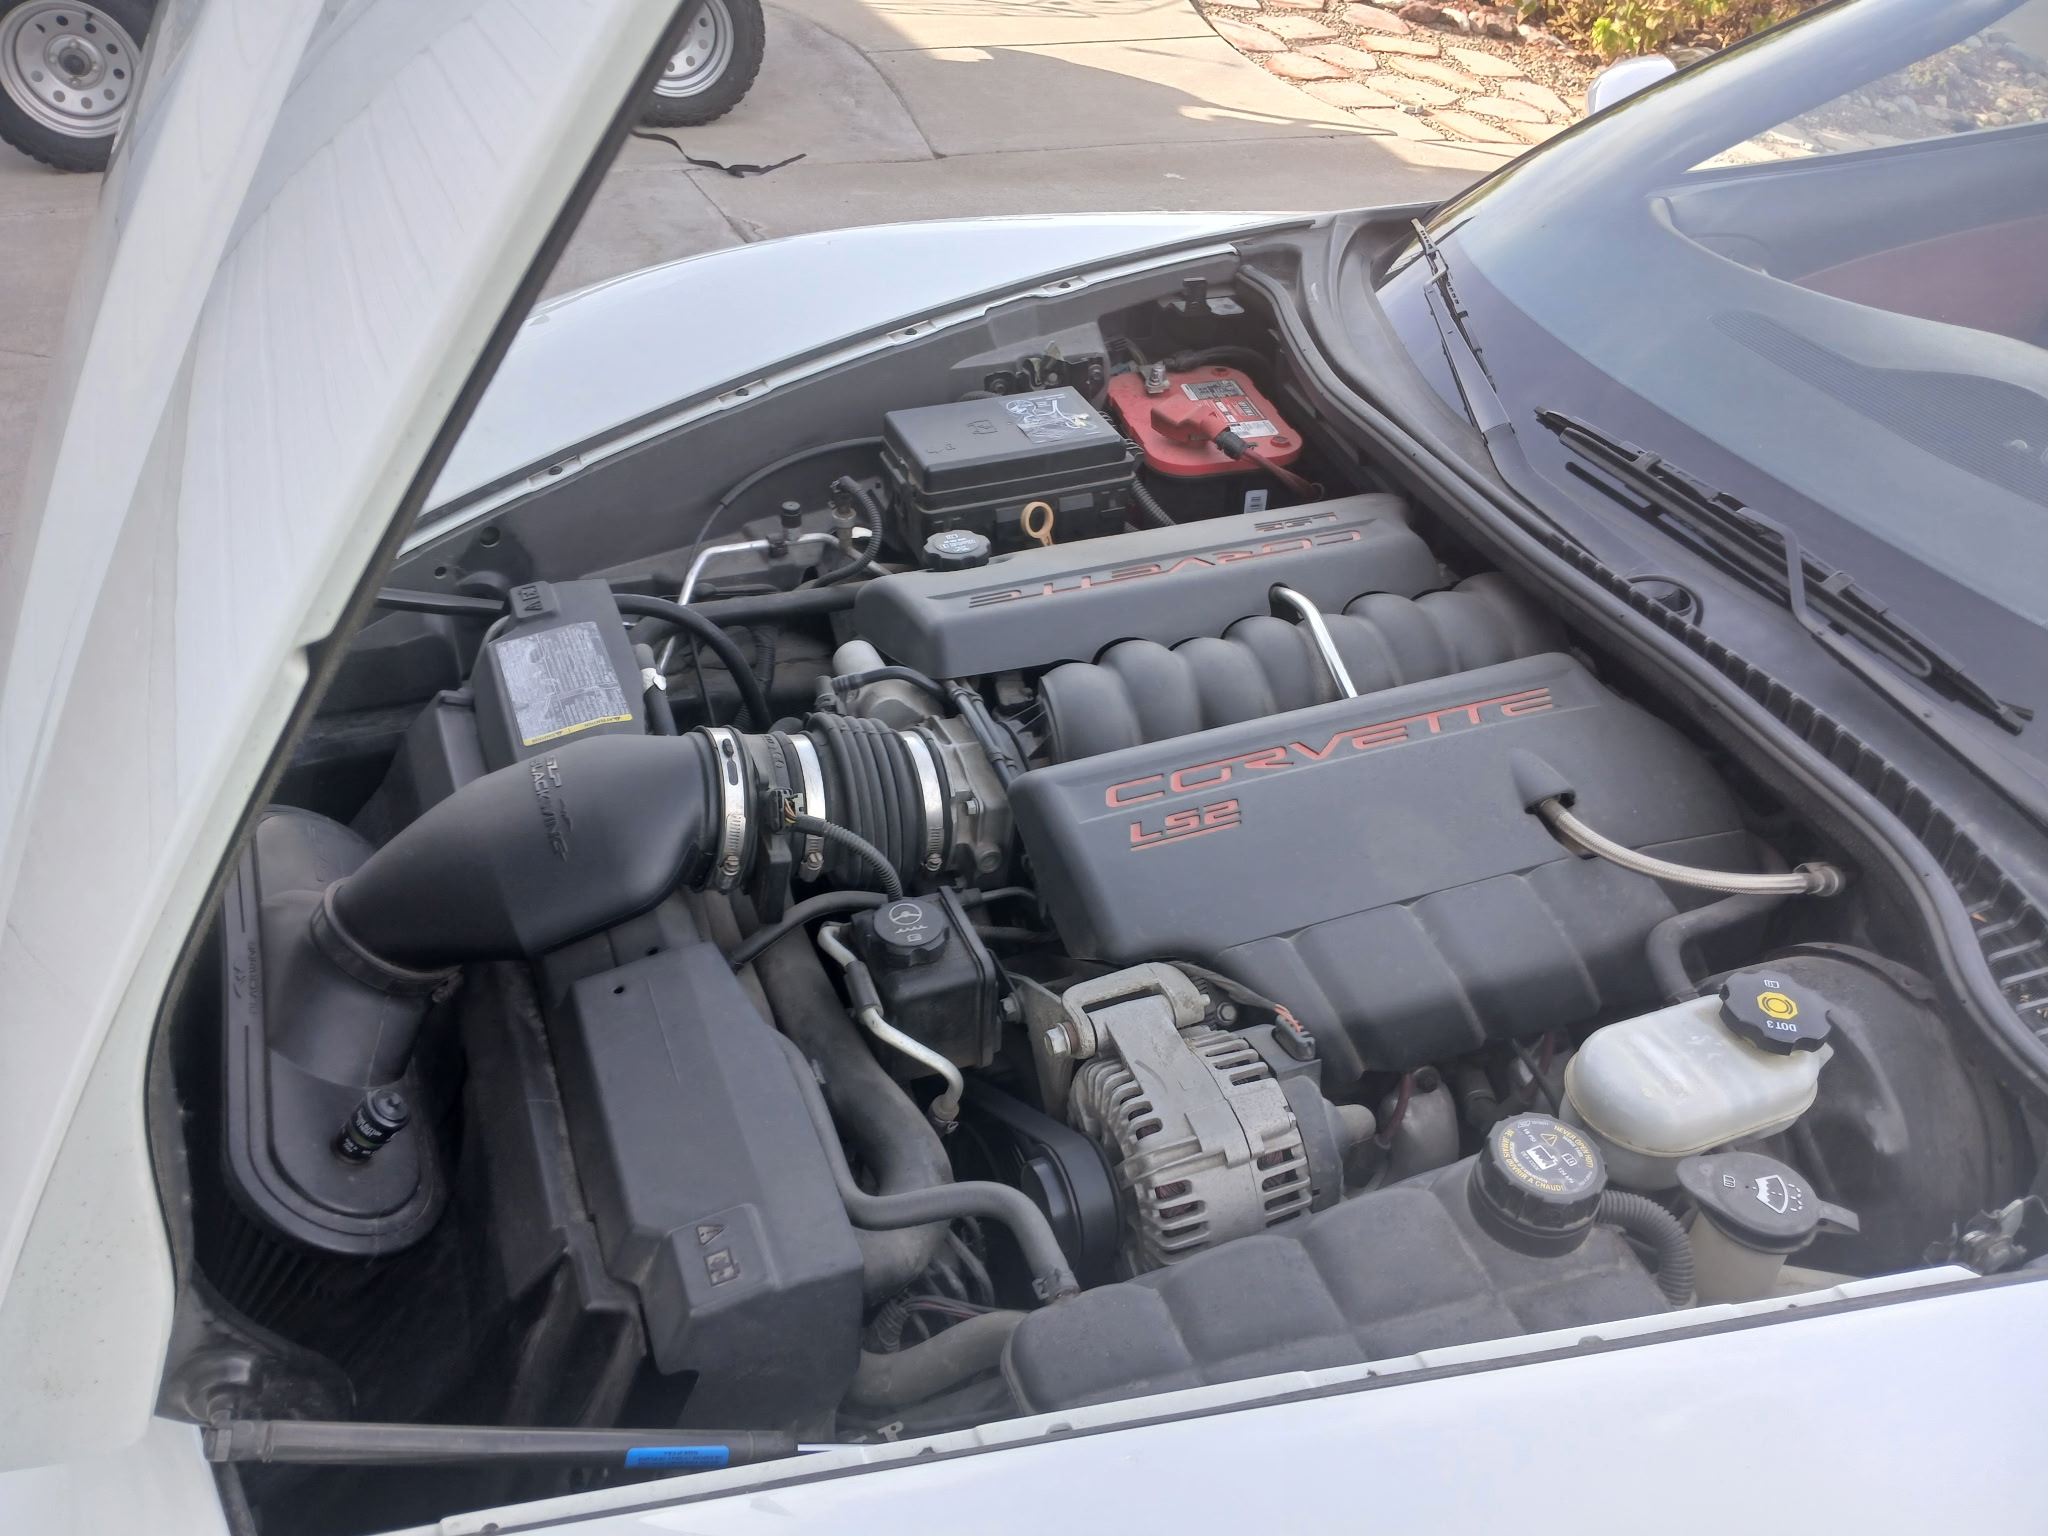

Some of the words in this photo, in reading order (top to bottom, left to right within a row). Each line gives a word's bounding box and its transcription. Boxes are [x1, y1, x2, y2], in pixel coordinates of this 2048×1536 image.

[968, 529, 1362, 609] CORVETTE
[1105, 686, 1554, 809] CORVETTE
[1129, 797, 1242, 844] LS2
[1766, 1020, 1774, 1029] 3
[1775, 1021, 1797, 1032] DOT
[1553, 1124, 1576, 1142] NEVER
[1574, 1136, 1590, 1155] OPEN
[1506, 1158, 1528, 1180] OUVRIR
